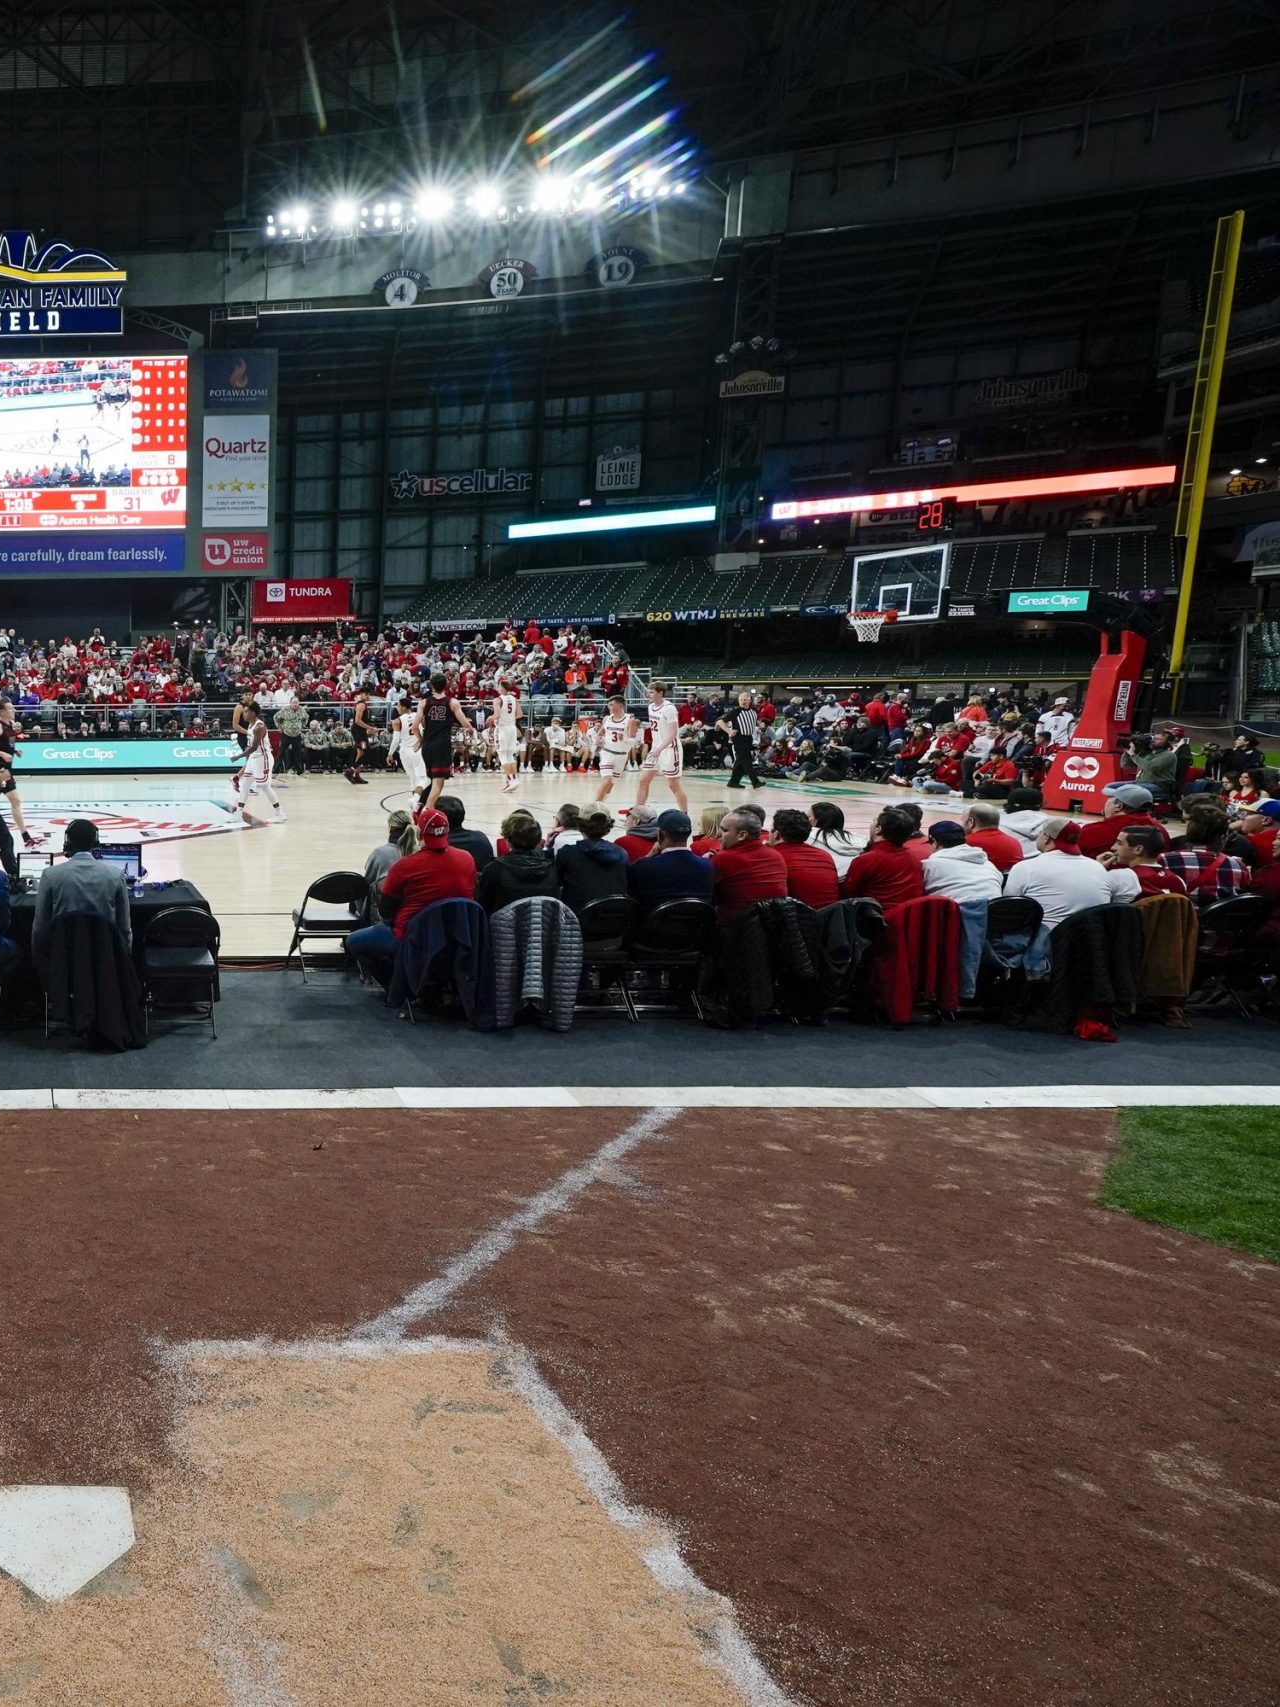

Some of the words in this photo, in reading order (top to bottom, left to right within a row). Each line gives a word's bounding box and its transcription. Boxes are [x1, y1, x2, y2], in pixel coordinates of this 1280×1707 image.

[488, 259, 524, 272] UECKER
[604, 262, 628, 282] 19
[382, 271, 421, 283] MOLITOR
[497, 272, 517, 287] 50
[40, 287, 123, 308] FAMILY
[393, 283, 406, 301] 4
[721, 376, 783, 396] Johnsonville
[976, 368, 1088, 402] Johnsonville
[209, 389, 268, 397] POTAWATOMI
[205, 437, 267, 459] Quartz
[167, 454, 176, 465] 8
[601, 460, 637, 474] LEINIE
[600, 473, 636, 486] LODGE
[123, 496, 141, 510] 31
[58, 516, 88, 525] Aurora
[90, 515, 118, 524] Health
[120, 515, 142, 523] Care
[919, 502, 943, 529] 28
[232, 539, 249, 547] uw
[11, 548, 65, 564] carefully,
[68, 548, 105, 561] dream
[107, 547, 167, 562] fearlessly.
[233, 547, 263, 555] credit
[233, 556, 264, 564] union
[289, 587, 332, 597] TUNDRA
[1017, 595, 1050, 607] Great
[1051, 594, 1080, 606] Clips
[646, 611, 672, 622] 620
[675, 609, 717, 621] WTMJ
[428, 705, 447, 721] 42
[507, 702, 513, 714] 5
[42, 748, 81, 760] Great
[82, 747, 116, 761] Clips
[173, 746, 211, 758] Great
[1059, 780, 1095, 792] Aurora
